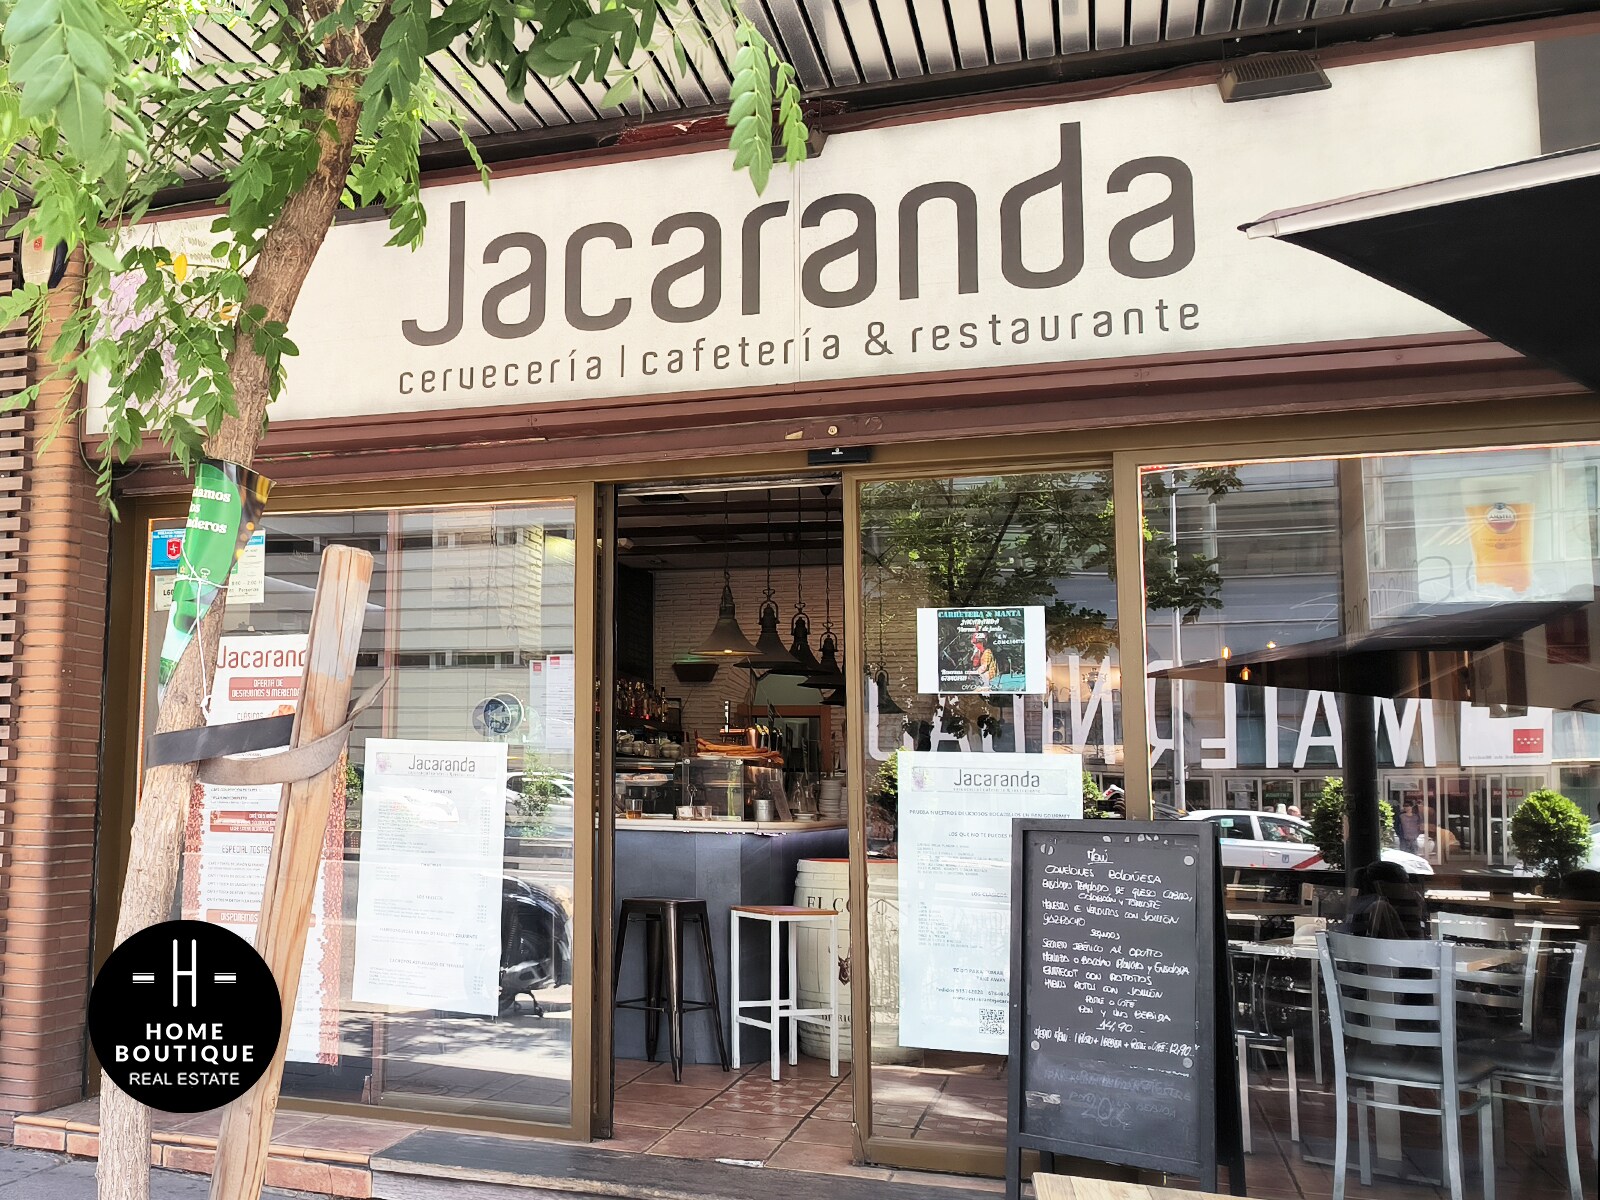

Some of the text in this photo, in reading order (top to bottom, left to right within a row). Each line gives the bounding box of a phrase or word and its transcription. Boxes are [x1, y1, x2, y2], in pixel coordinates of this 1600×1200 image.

[401, 121, 1196, 347] Jacaranda
[641, 328, 840, 376] cafetería
[864, 321, 894, 356] &
[911, 298, 1200, 354] restaurante
[938, 609, 983, 619] CARRETERA
[995, 609, 1021, 617] MANTA
[275, 679, 284, 687] DE
[408, 754, 476, 773] Jacaranda
[953, 768, 1040, 789] Jacaranda
